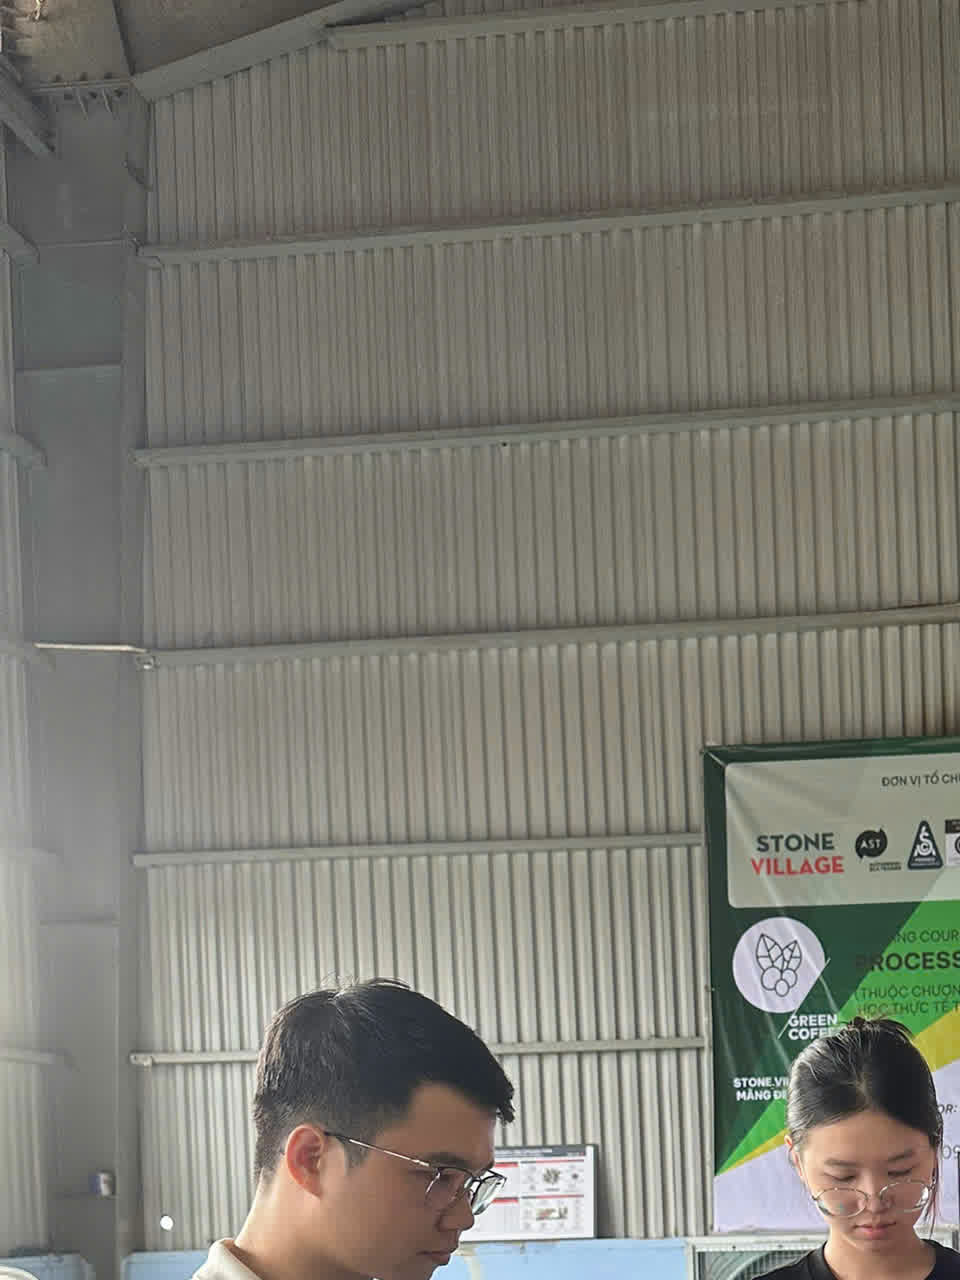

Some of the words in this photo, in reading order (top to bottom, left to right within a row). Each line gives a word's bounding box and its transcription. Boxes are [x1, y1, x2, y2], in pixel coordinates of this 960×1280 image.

[881, 775, 908, 787] ĐƠN
[909, 775, 921, 789] VỊ
[756, 832, 835, 852] STONE
[860, 839, 881, 849] AST
[750, 856, 845, 876] VILLAGE
[788, 1014, 838, 1027] GREEN
